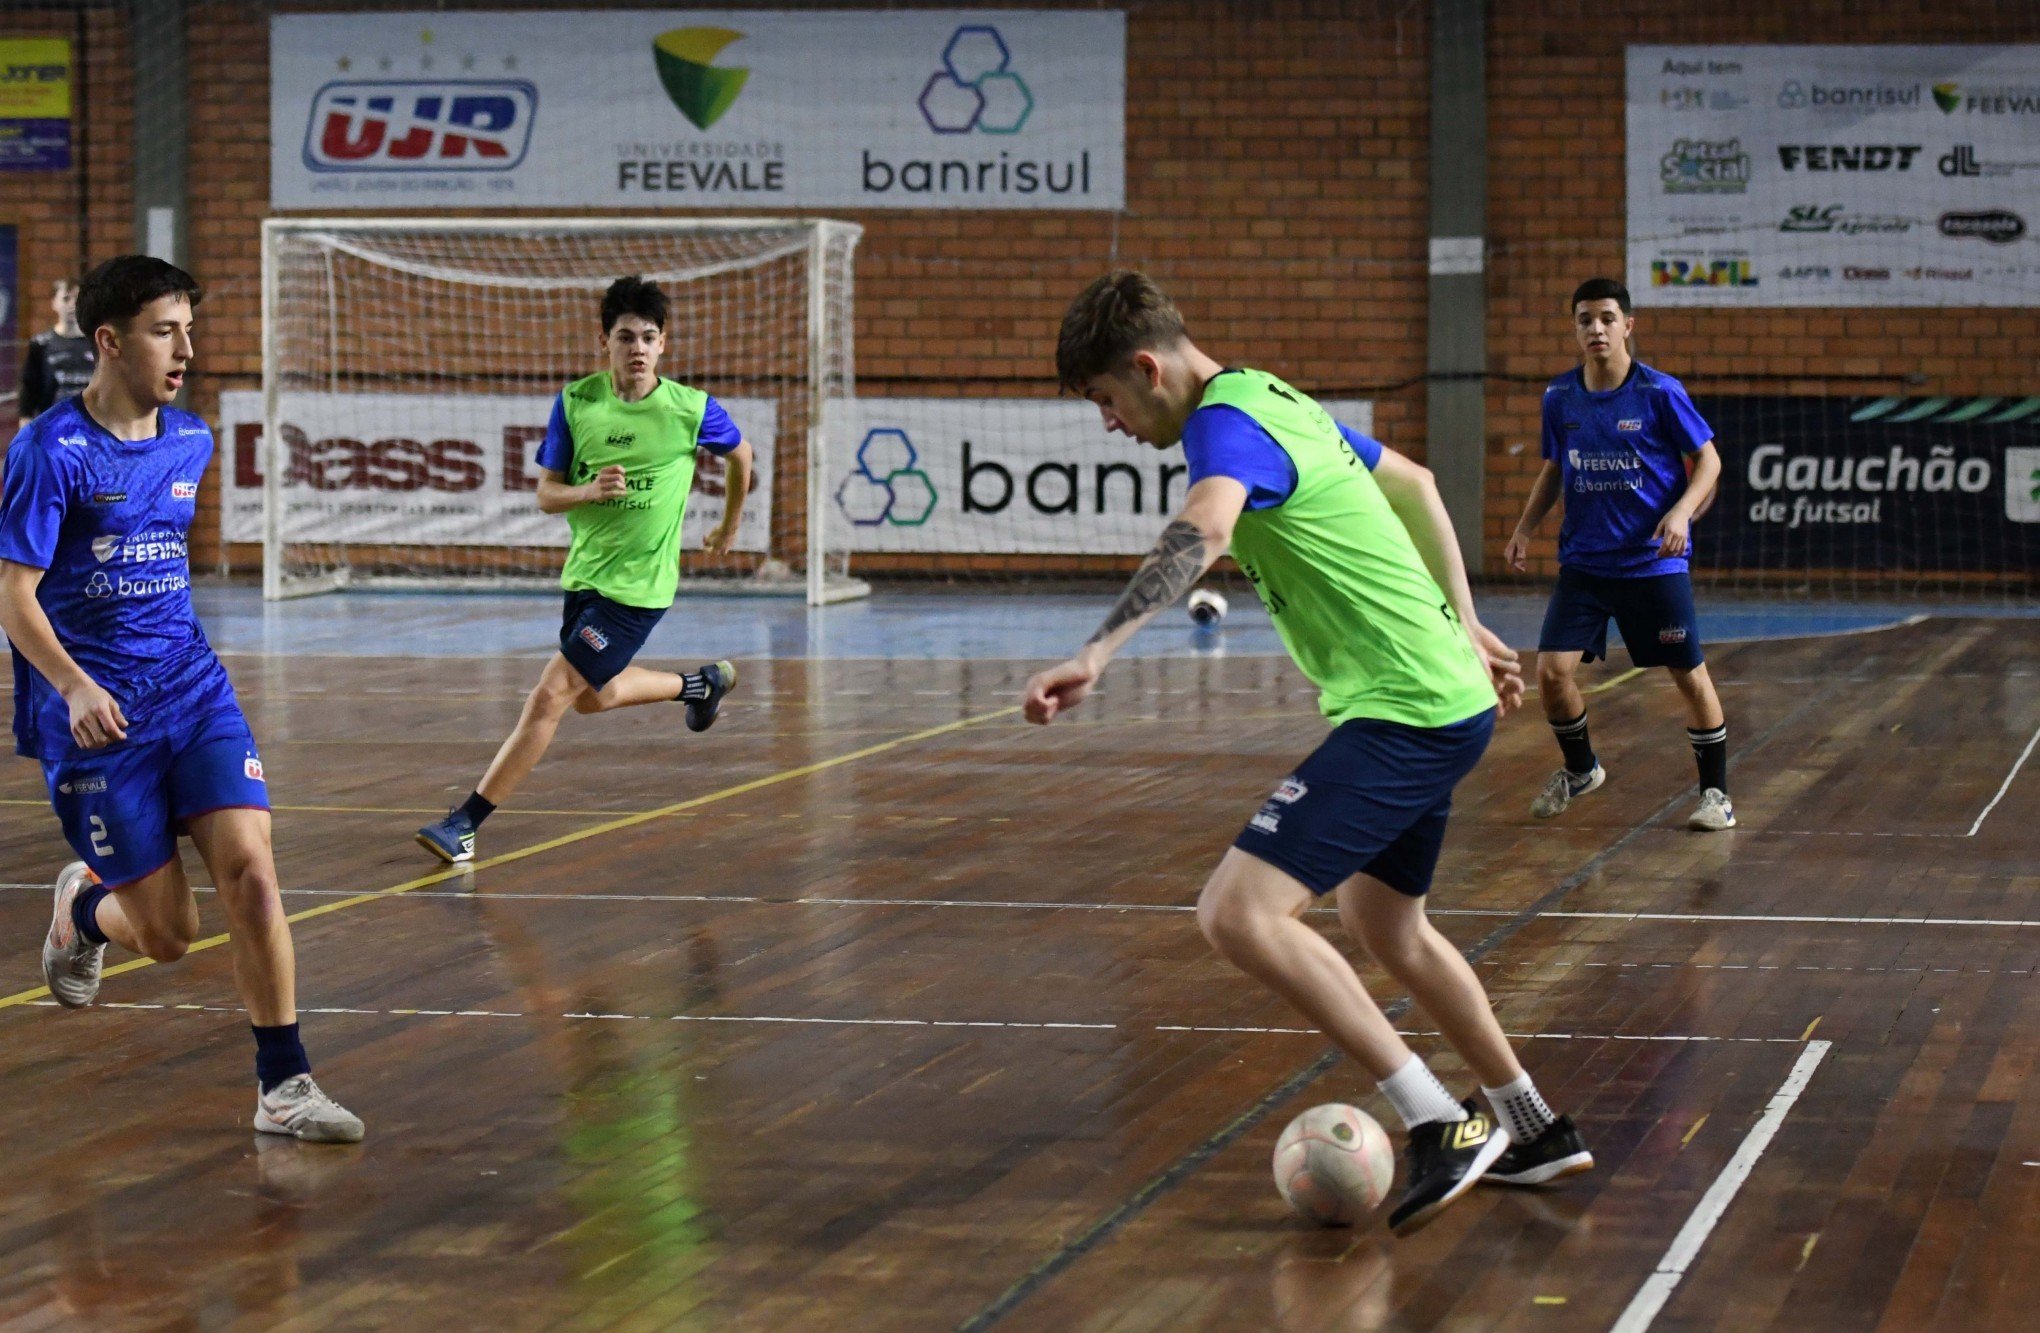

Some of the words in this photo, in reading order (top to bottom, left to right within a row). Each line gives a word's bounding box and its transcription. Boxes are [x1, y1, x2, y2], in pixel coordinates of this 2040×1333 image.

[1811, 83, 1920, 106] banrisul
[1966, 96, 2040, 114] FEEVA
[321, 96, 517, 161] UJR
[615, 143, 784, 158] UNIVERSIDADE
[1778, 145, 1922, 171] FENDT
[617, 161, 785, 191] FEEVALE
[862, 149, 1090, 193] banrisul
[234, 423, 487, 492] Dass
[1583, 457, 1641, 471] FEEVALE
[1748, 443, 1992, 493] Gauchão
[962, 440, 1188, 515] banr
[1585, 476, 1643, 492] banrisul
[1750, 496, 1786, 523] de
[1788, 494, 1882, 529] futsal
[89, 815, 115, 857] 2
